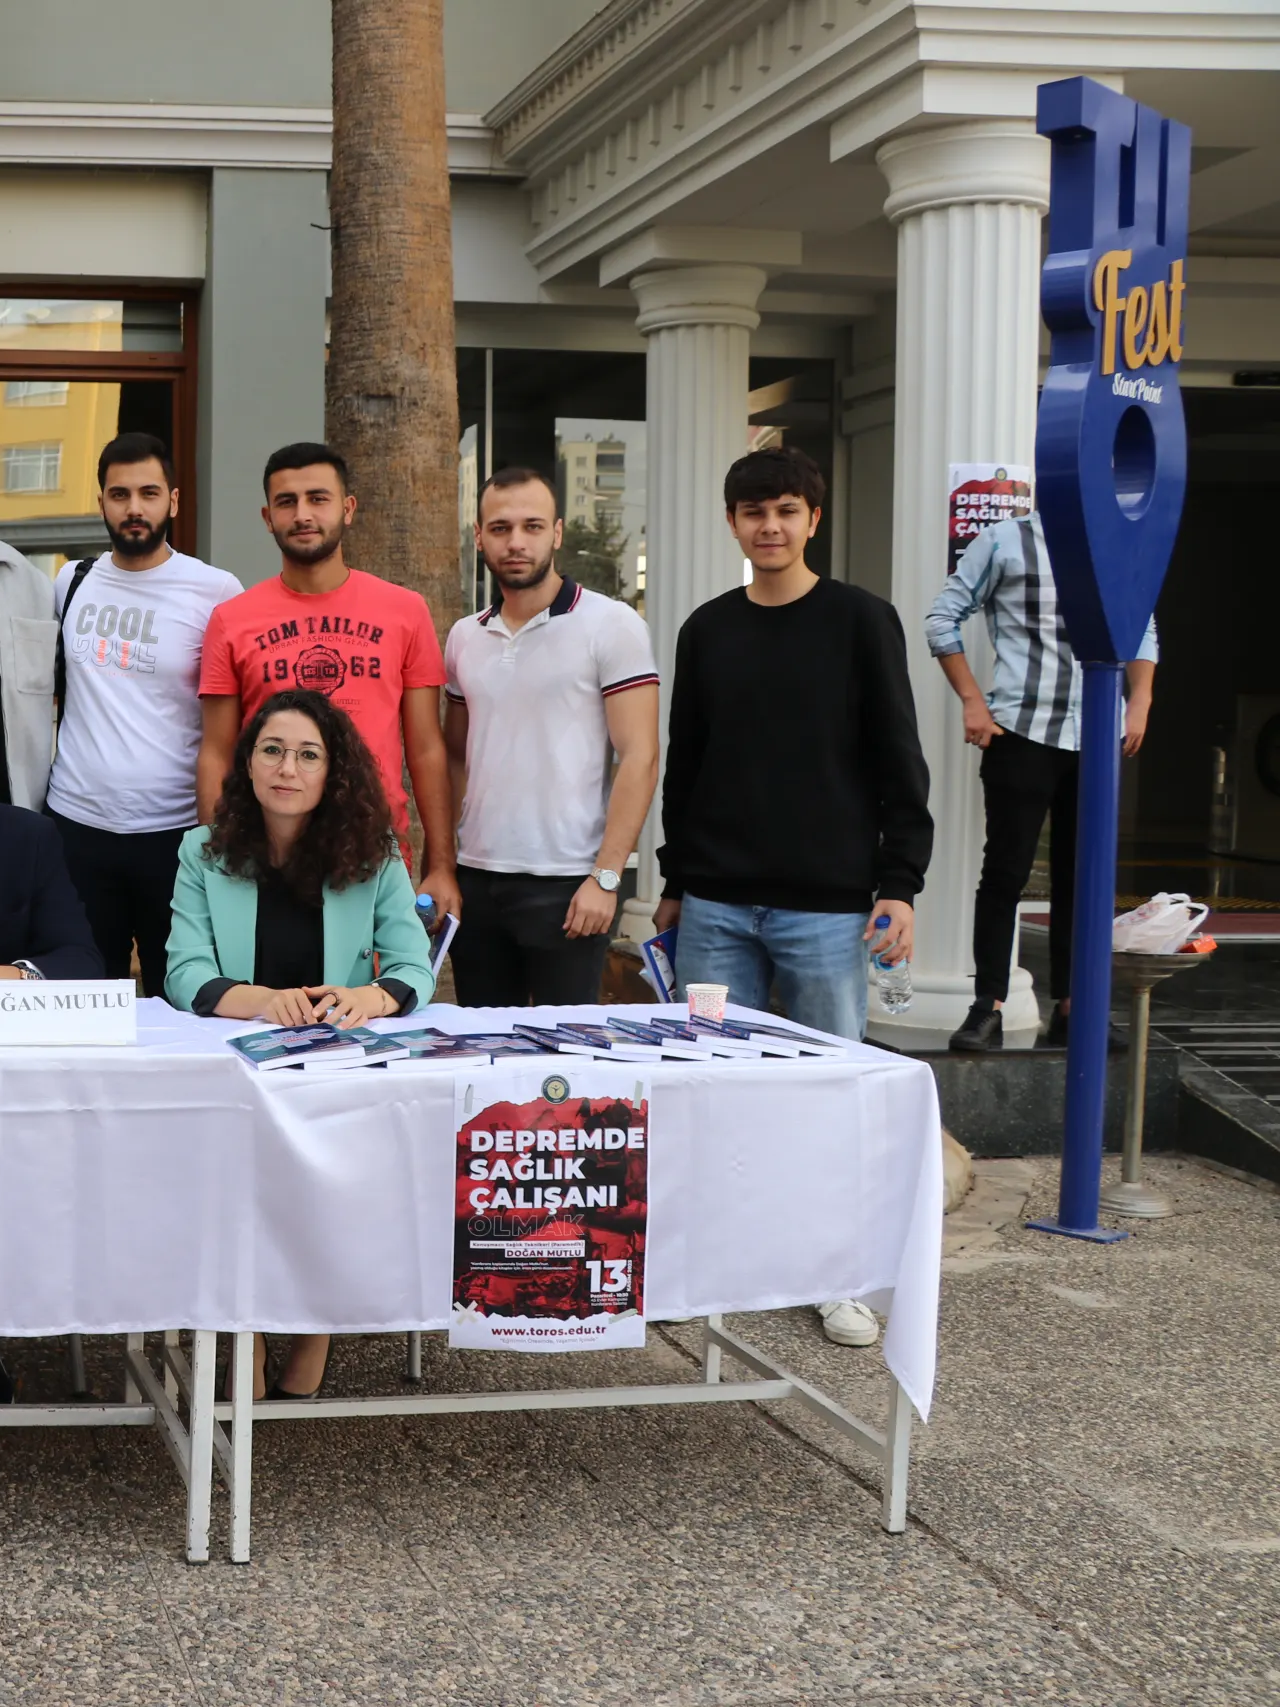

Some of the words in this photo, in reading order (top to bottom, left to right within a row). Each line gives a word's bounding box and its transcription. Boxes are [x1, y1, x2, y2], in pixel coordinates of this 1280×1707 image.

[1093, 249, 1186, 375] Fest
[955, 505, 1013, 520] SAĞLIK
[956, 494, 1031, 508] DEPREMDE
[76, 603, 158, 644] COOL
[255, 620, 299, 650] TOM
[305, 616, 384, 644] TAILOR
[302, 635, 341, 643] FASHION
[345, 637, 369, 648] GEAR
[54, 992, 130, 1010] MUTLU
[471, 1126, 645, 1152] DEPREMDE
[470, 1153, 586, 1182] SAĞLIK
[470, 1185, 618, 1216] ÇALIŞANI
[467, 1214, 585, 1238] OLMAK
[506, 1248, 544, 1256] DOĞAN
[586, 1259, 628, 1292] 13
[491, 1326, 606, 1336] www.toros.edu.tr
